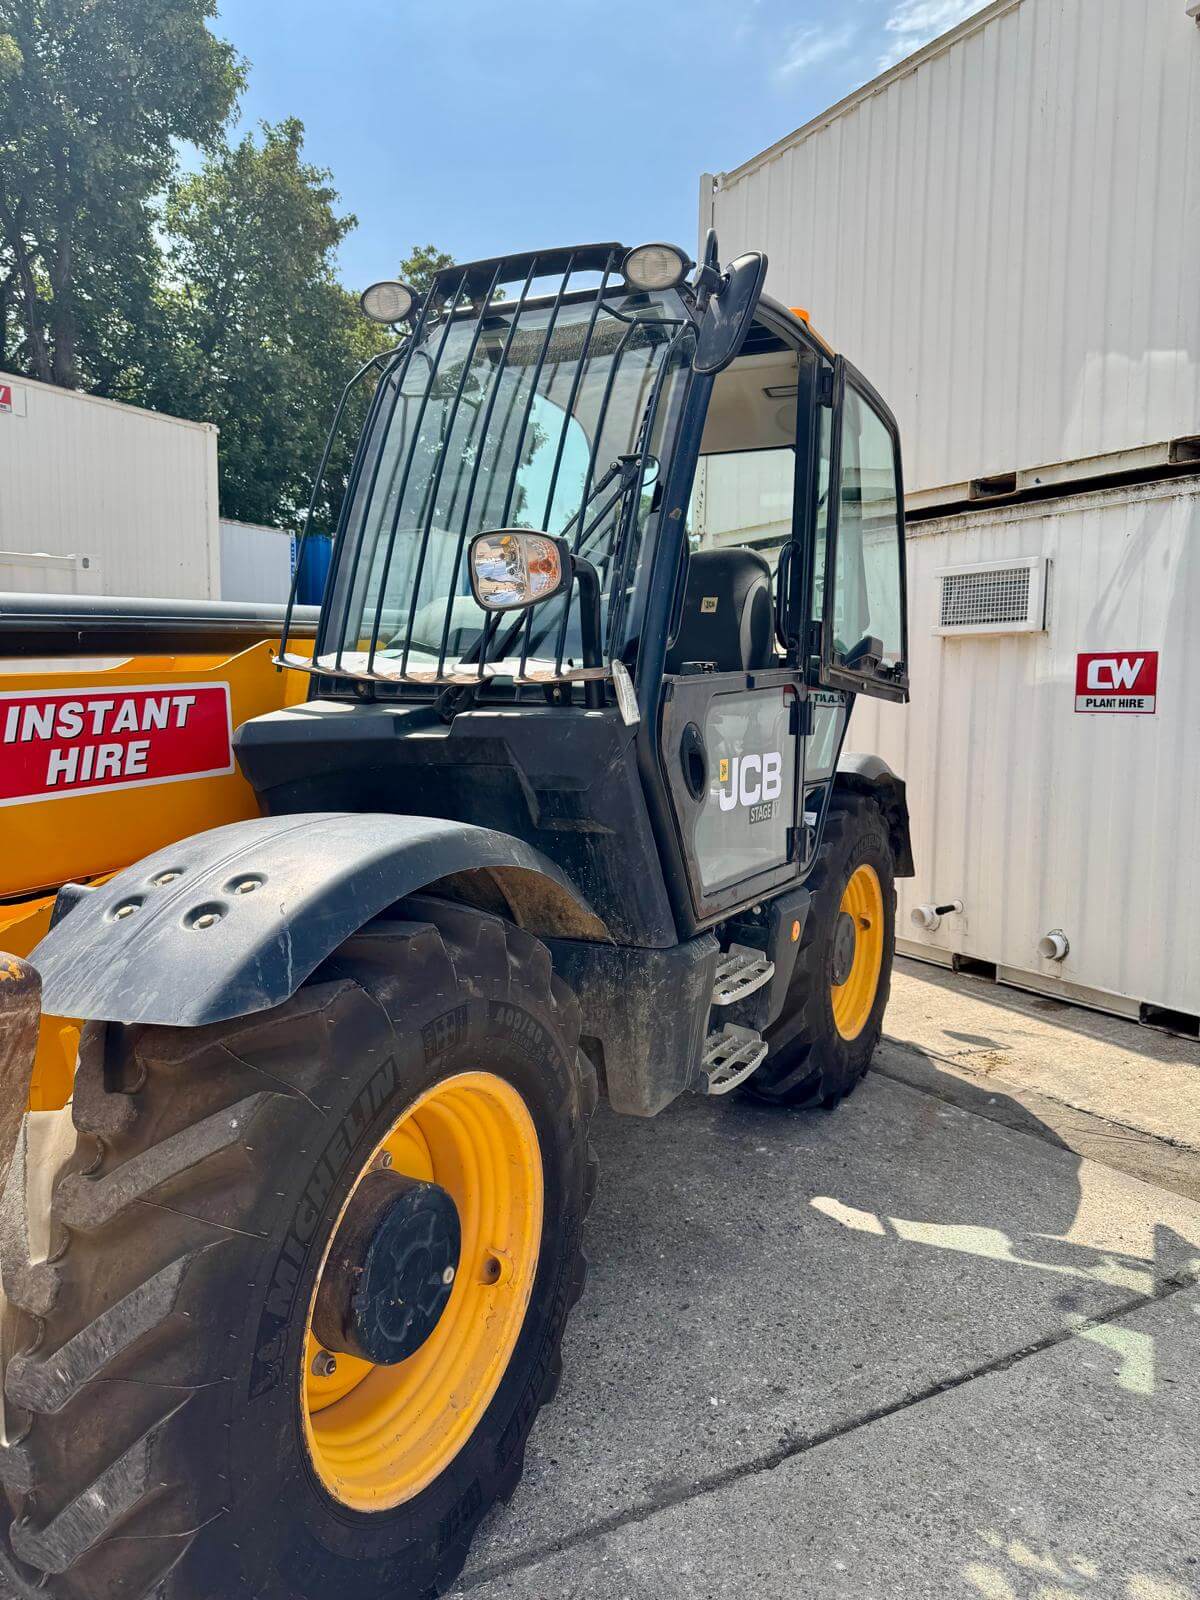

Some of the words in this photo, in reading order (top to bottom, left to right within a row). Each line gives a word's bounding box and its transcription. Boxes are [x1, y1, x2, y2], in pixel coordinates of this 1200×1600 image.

[1087, 658, 1144, 689] CW
[4, 696, 196, 743] INSTANT
[1085, 698, 1117, 708] PLANT
[1118, 698, 1145, 708] HIRE
[46, 740, 151, 786] HIRE
[719, 752, 782, 811] JCB
[750, 804, 772, 823] STAGE
[263, 1054, 400, 1321] MICHELIN
